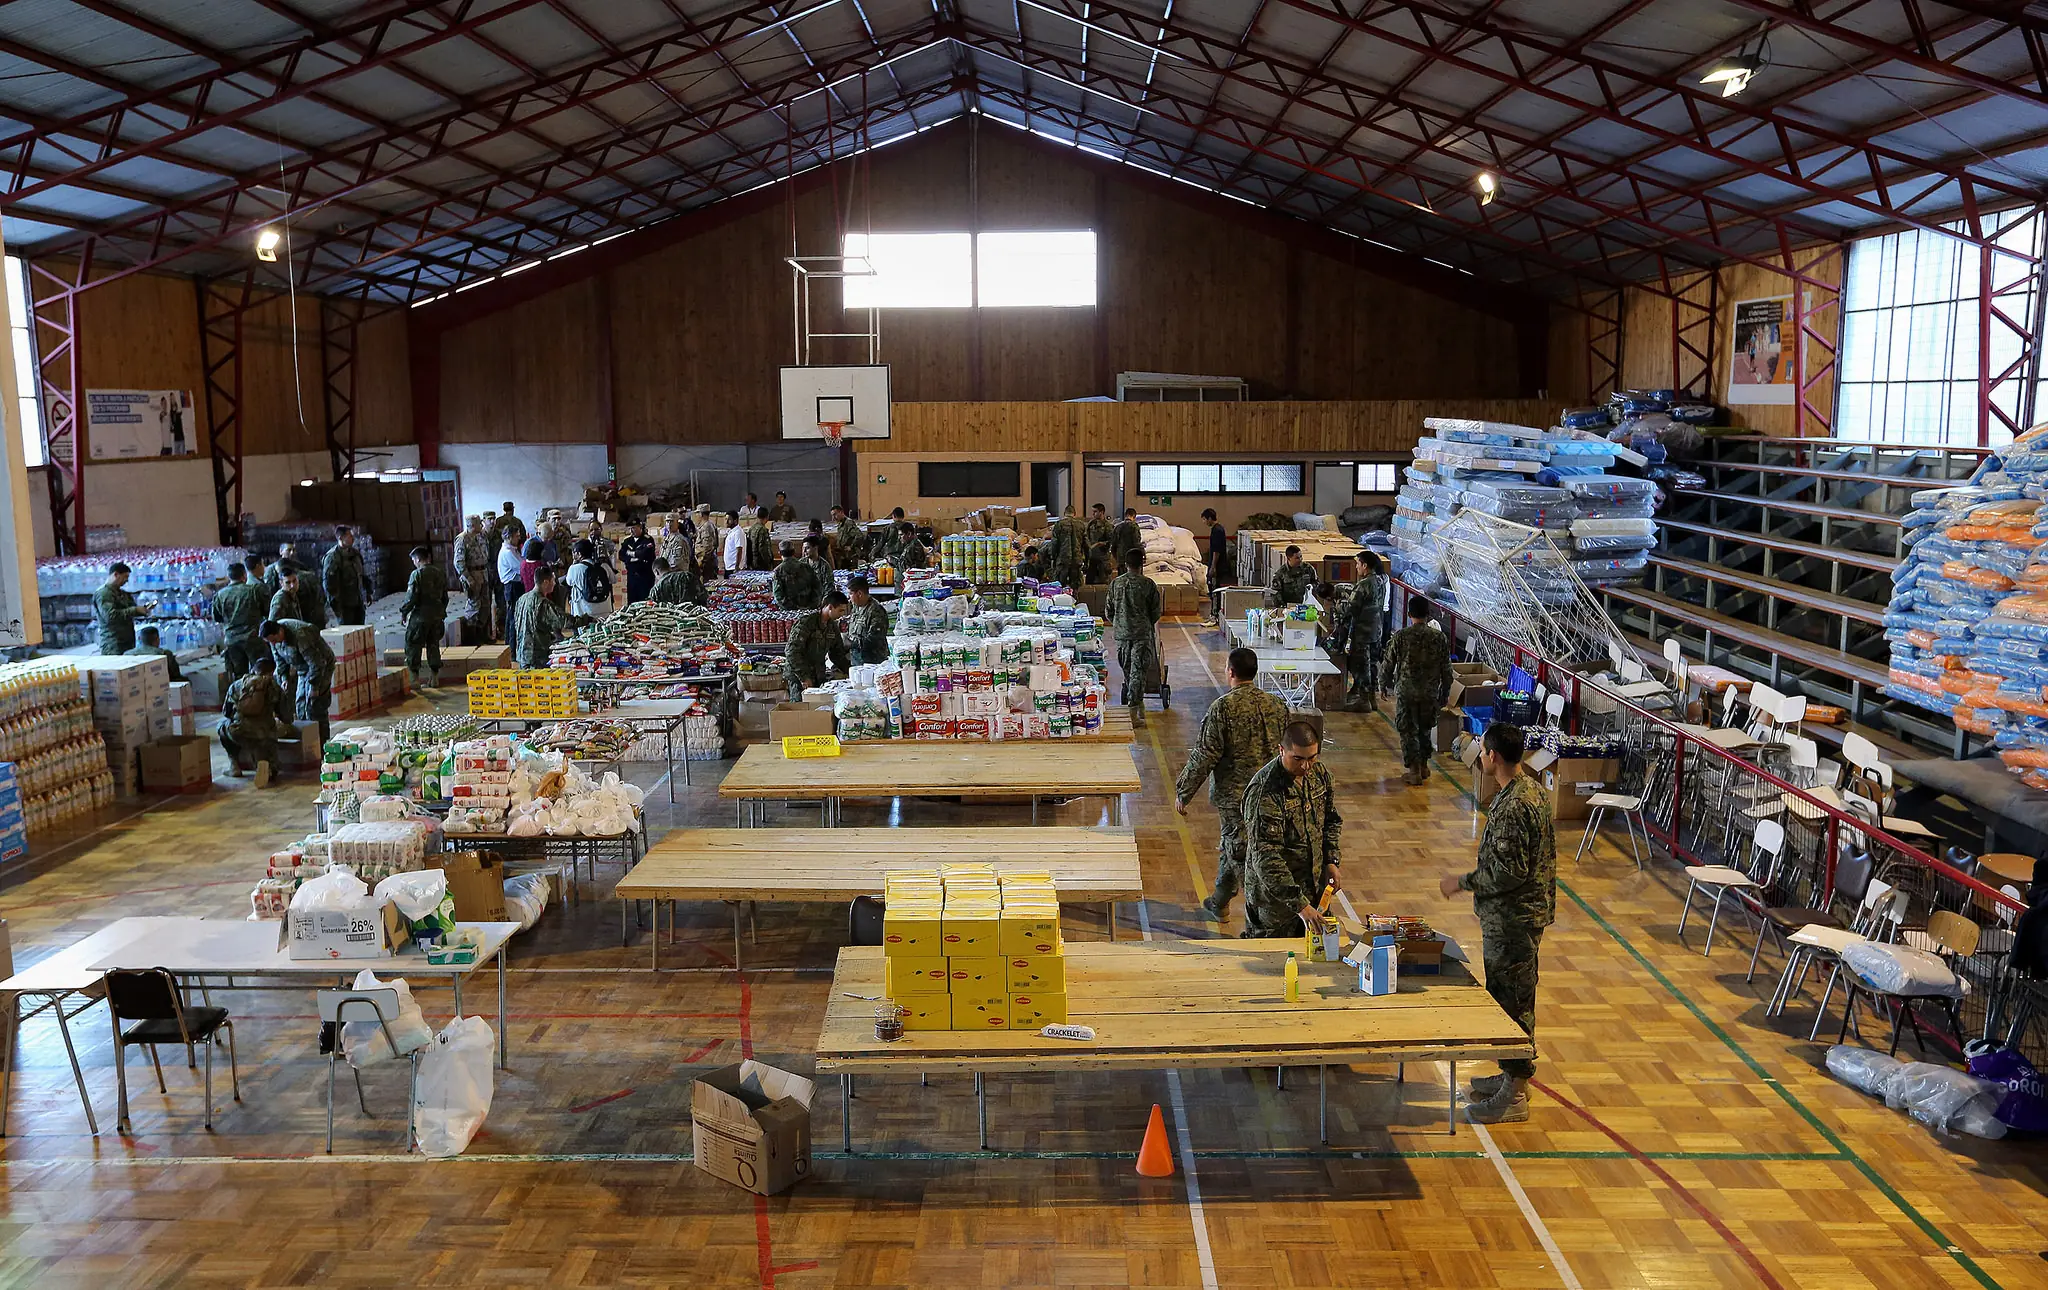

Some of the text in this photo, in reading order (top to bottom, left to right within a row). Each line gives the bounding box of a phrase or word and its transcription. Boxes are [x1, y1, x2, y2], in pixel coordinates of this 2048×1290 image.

[919, 722, 947, 730] Confort
[960, 722, 984, 730] Confort
[351, 920, 374, 933] 26%
[1047, 1028, 1080, 1038] CRACKELET
